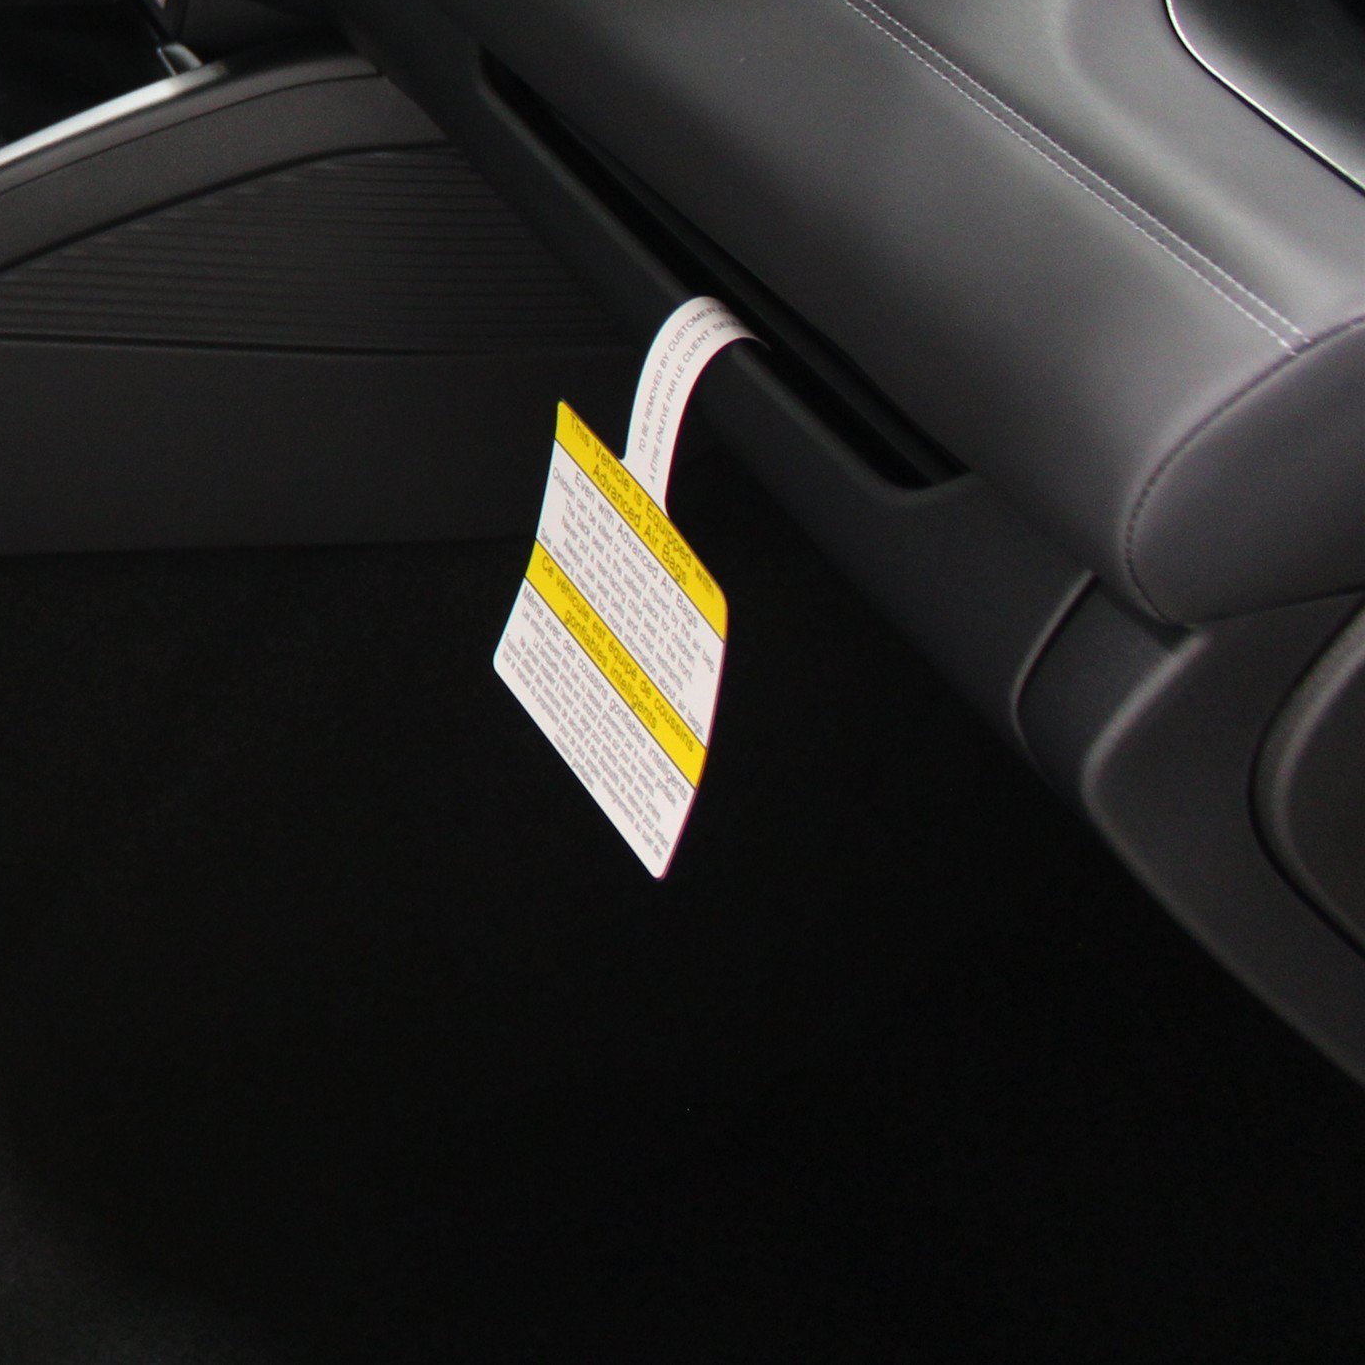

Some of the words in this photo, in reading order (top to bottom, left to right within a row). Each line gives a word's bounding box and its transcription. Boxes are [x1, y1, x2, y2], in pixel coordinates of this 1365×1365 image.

[682, 329, 711, 363] CLIENT
[574, 469, 596, 504] Even
[596, 497, 615, 527] with
[616, 521, 659, 580] Advanced
[659, 573, 674, 598] Air
[674, 591, 699, 632] Bags
[591, 439, 631, 493] Vehicle
[632, 486, 643, 508] is
[644, 501, 693, 568] Equipped
[592, 461, 642, 528] Advanced
[643, 522, 659, 550] Air
[659, 542, 689, 589] Bags
[540, 553, 555, 579] Ce
[591, 618, 606, 645] est
[638, 676, 652, 702] de
[653, 695, 695, 754] coussins
[543, 613, 562, 643] avec
[561, 634, 577, 661] des
[576, 653, 609, 702] coussins
[608, 693, 648, 752] gonflables
[646, 741, 689, 804] intelligents
[563, 604, 609, 672] gonflables
[608, 661, 658, 734] intelligents
